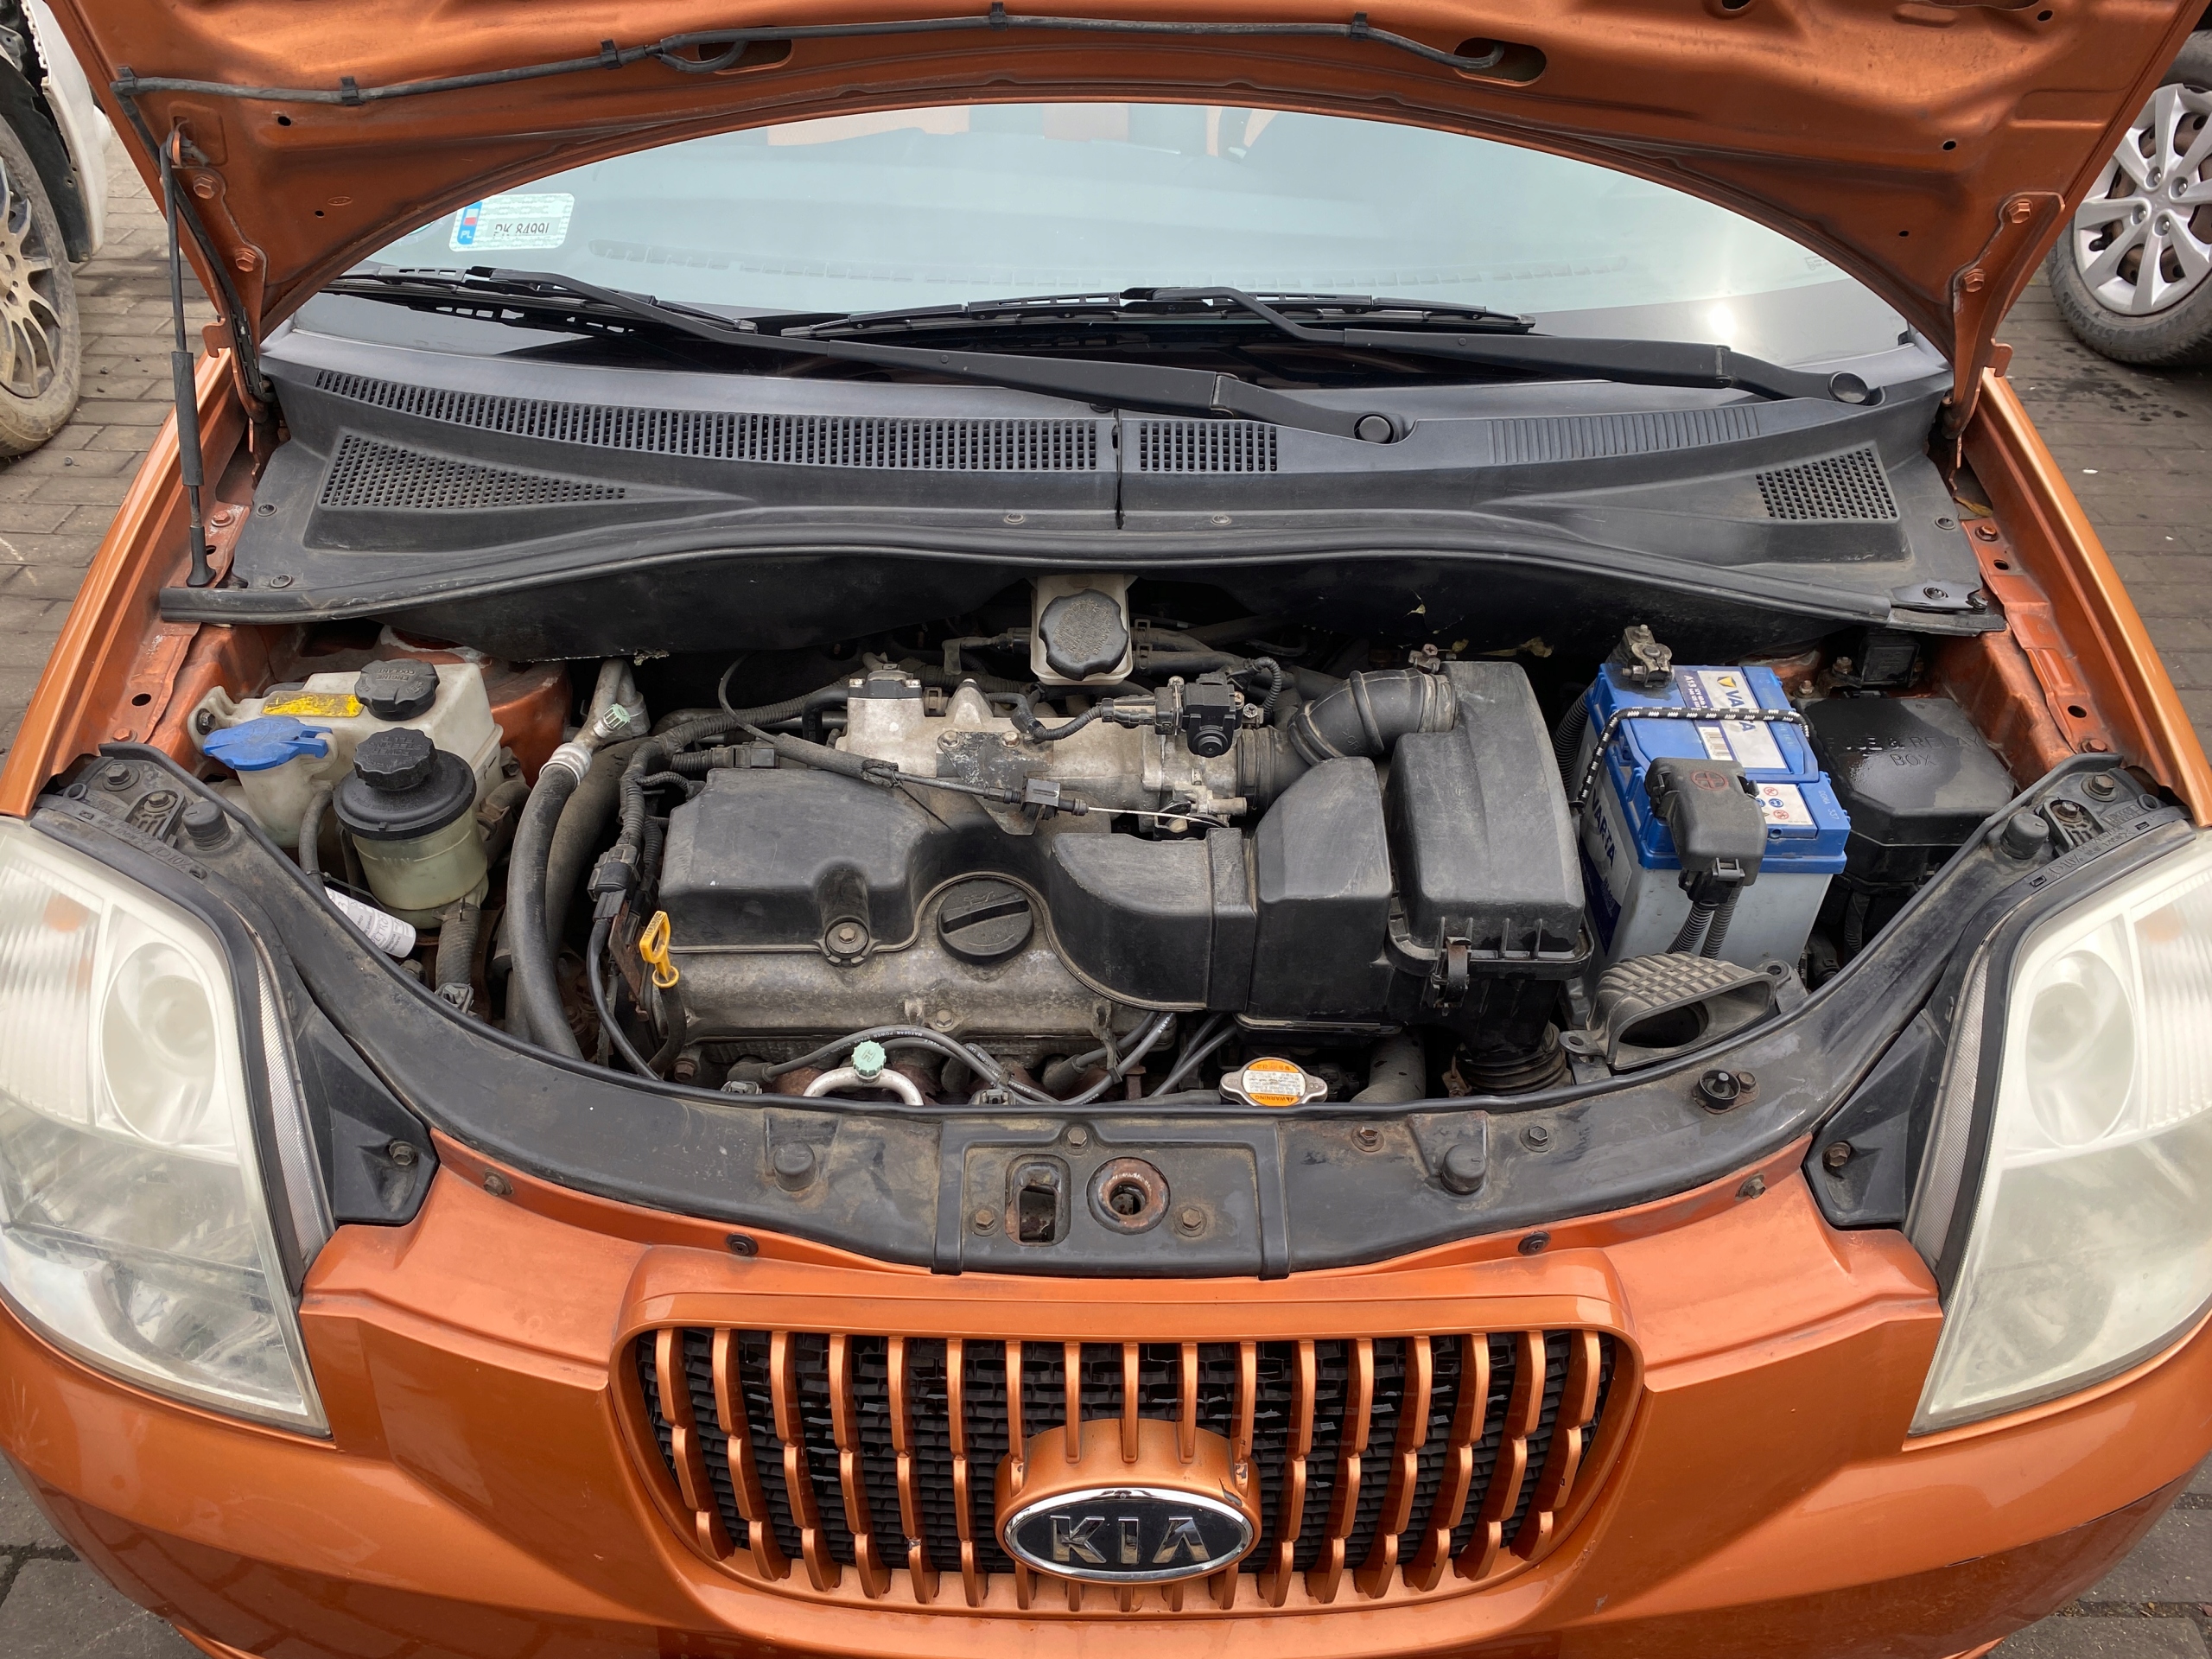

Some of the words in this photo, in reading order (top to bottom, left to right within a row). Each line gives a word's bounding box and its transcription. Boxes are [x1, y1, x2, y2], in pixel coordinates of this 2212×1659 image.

[460, 230, 473, 239] PL
[375, 673, 410, 682] ENGINE
[1683, 675, 1697, 688] A13
[1726, 690, 1757, 732] VAA
[1910, 735, 1980, 749] RELAY
[1890, 753, 1938, 766] BOX
[1592, 788, 1616, 868] VARTA
[382, 855, 411, 867] MIN
[1157, 1016, 1171, 1034] CABLE
[861, 1049, 876, 1063] H
[1049, 1515, 1211, 1564] KIA
